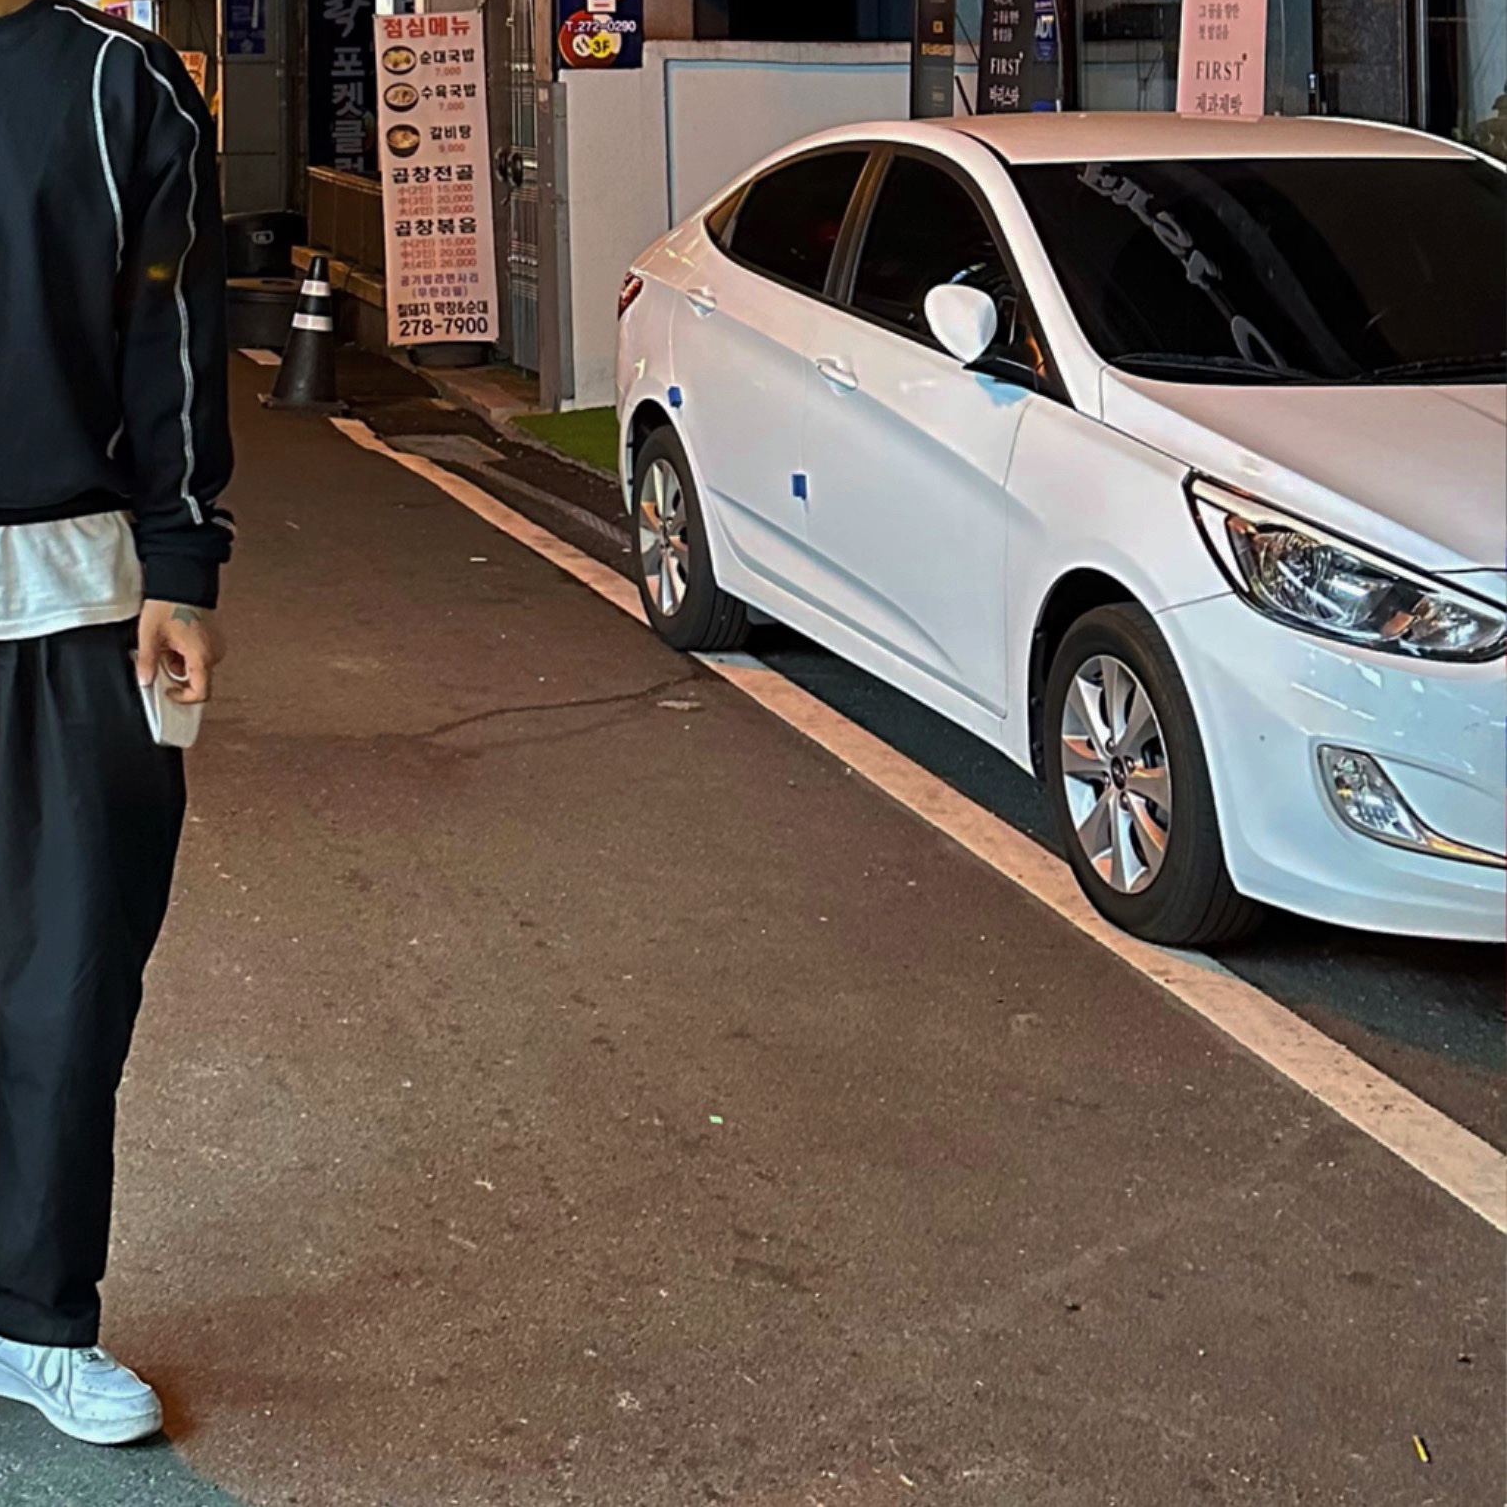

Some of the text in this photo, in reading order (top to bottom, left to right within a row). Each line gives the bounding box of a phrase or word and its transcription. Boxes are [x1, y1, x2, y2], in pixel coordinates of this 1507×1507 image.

[383, 16, 471, 39] 점심메뉴
[1035, 15, 1054, 38] ADT
[420, 48, 475, 65] 순대국밥
[592, 39, 611, 54] 3F
[990, 56, 1021, 76] FIRST
[1196, 61, 1244, 81] FIRST
[430, 125, 472, 140] 갈비탕
[392, 164, 474, 184] 곱창전골
[394, 217, 477, 237] 곱창볶음
[399, 317, 489, 337] 278-7900
